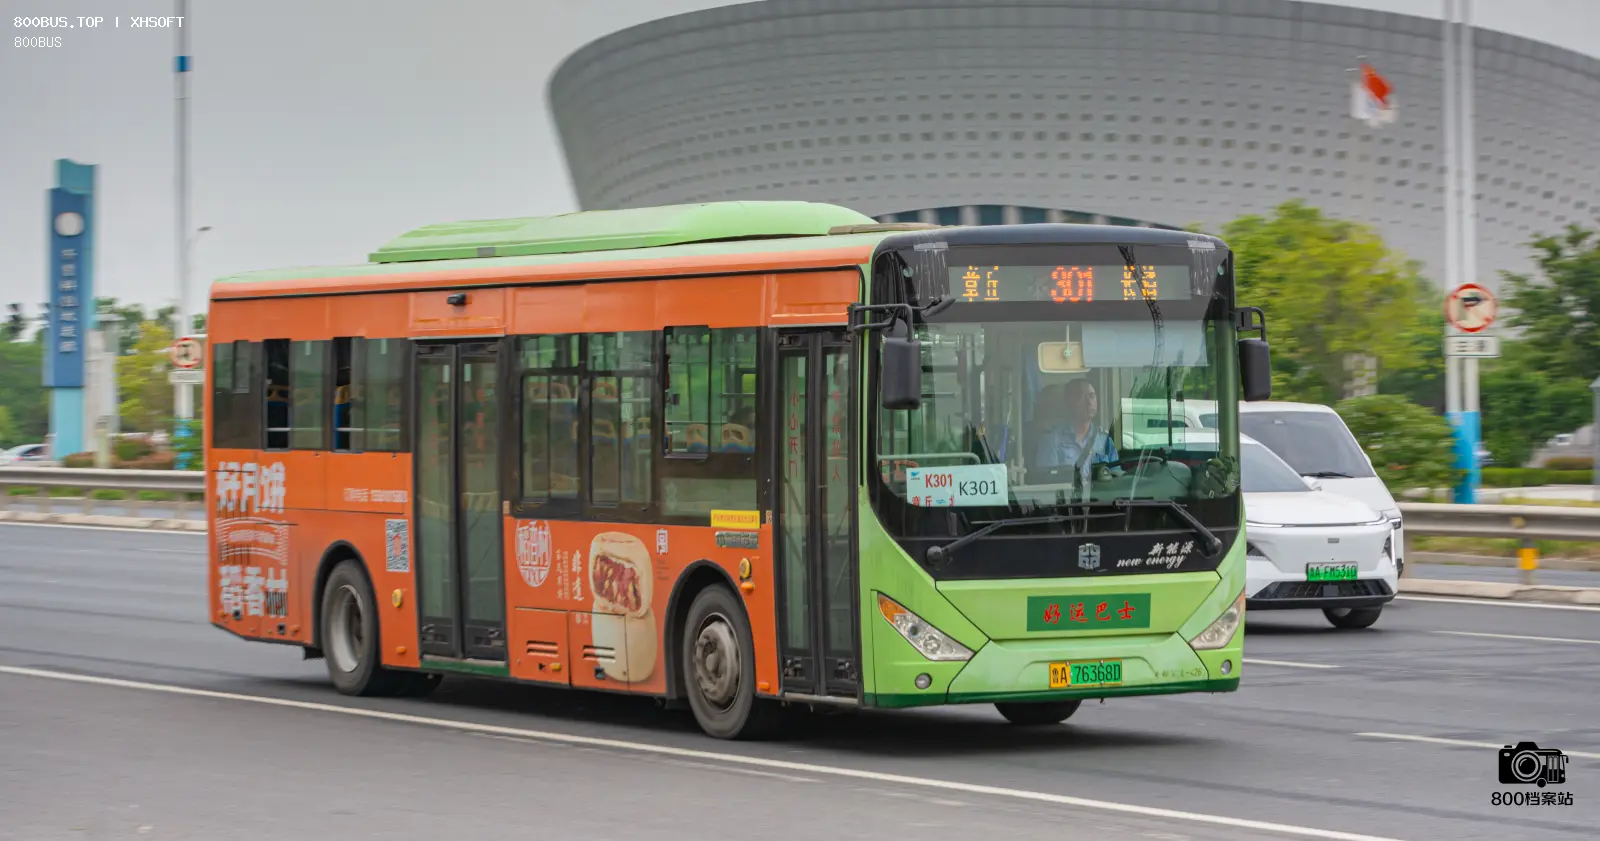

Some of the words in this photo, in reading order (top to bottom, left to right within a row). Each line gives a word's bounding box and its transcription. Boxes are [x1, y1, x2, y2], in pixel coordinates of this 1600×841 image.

[962, 265, 1000, 302] 章丘
[1051, 266, 1093, 303] 301
[925, 473, 953, 488] K301
[959, 480, 999, 496] K301
[1148, 541, 1194, 556] 新能源
[1116, 558, 1143, 568] new
[1145, 555, 1187, 570] energy
[1043, 601, 1135, 625] 好运巴士
[1073, 663, 1121, 683] 76368D
